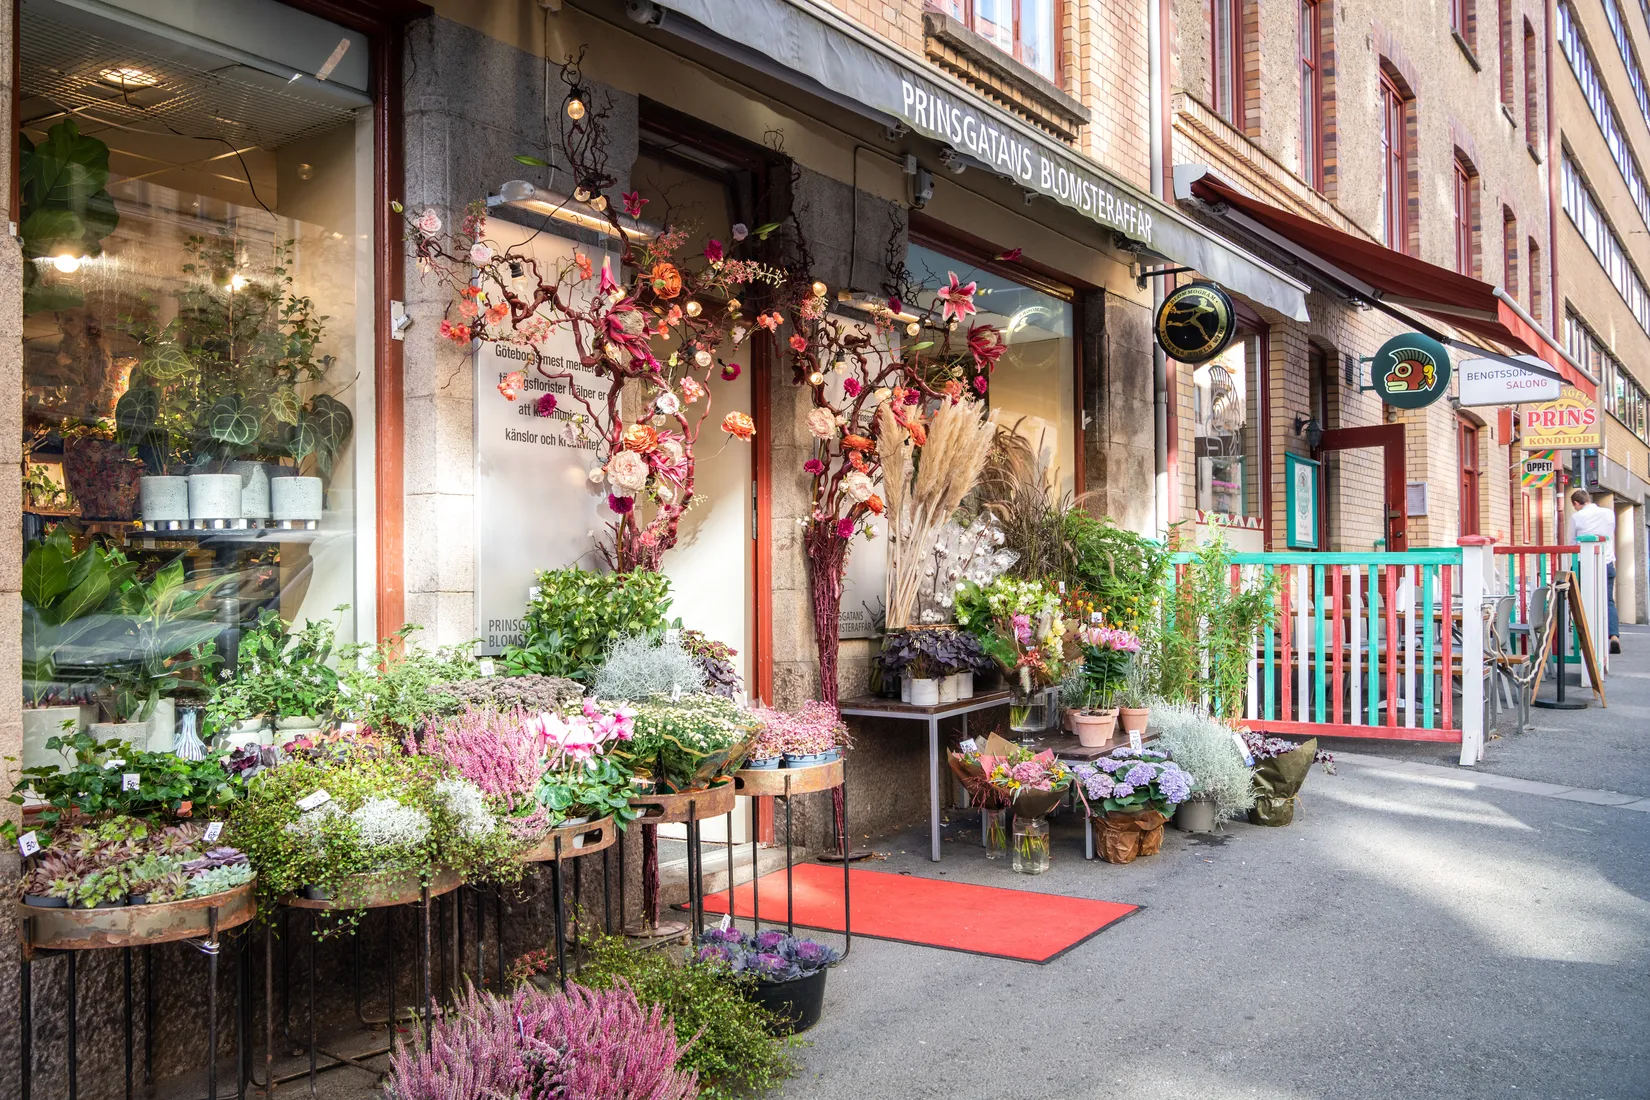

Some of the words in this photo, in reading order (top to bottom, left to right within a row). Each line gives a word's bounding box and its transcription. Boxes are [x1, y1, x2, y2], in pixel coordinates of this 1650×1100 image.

[901, 79, 1033, 181] PRINSGATANS
[1040, 156, 1152, 243] BLOMSTERAFFÄR
[543, 355, 564, 368] mest
[1506, 379, 1547, 389] SALONG
[569, 383, 596, 400] hälper
[518, 403, 531, 416] att
[1527, 408, 1596, 428] PRINS
[505, 428, 538, 444] känslor
[540, 434, 556, 446] och
[1529, 435, 1595, 445] KONDITORI
[1527, 461, 1552, 472] ÖPPET!
[839, 611, 864, 621] SGATANS
[488, 619, 531, 632] PRINSGA
[488, 634, 523, 648] BLOMS
